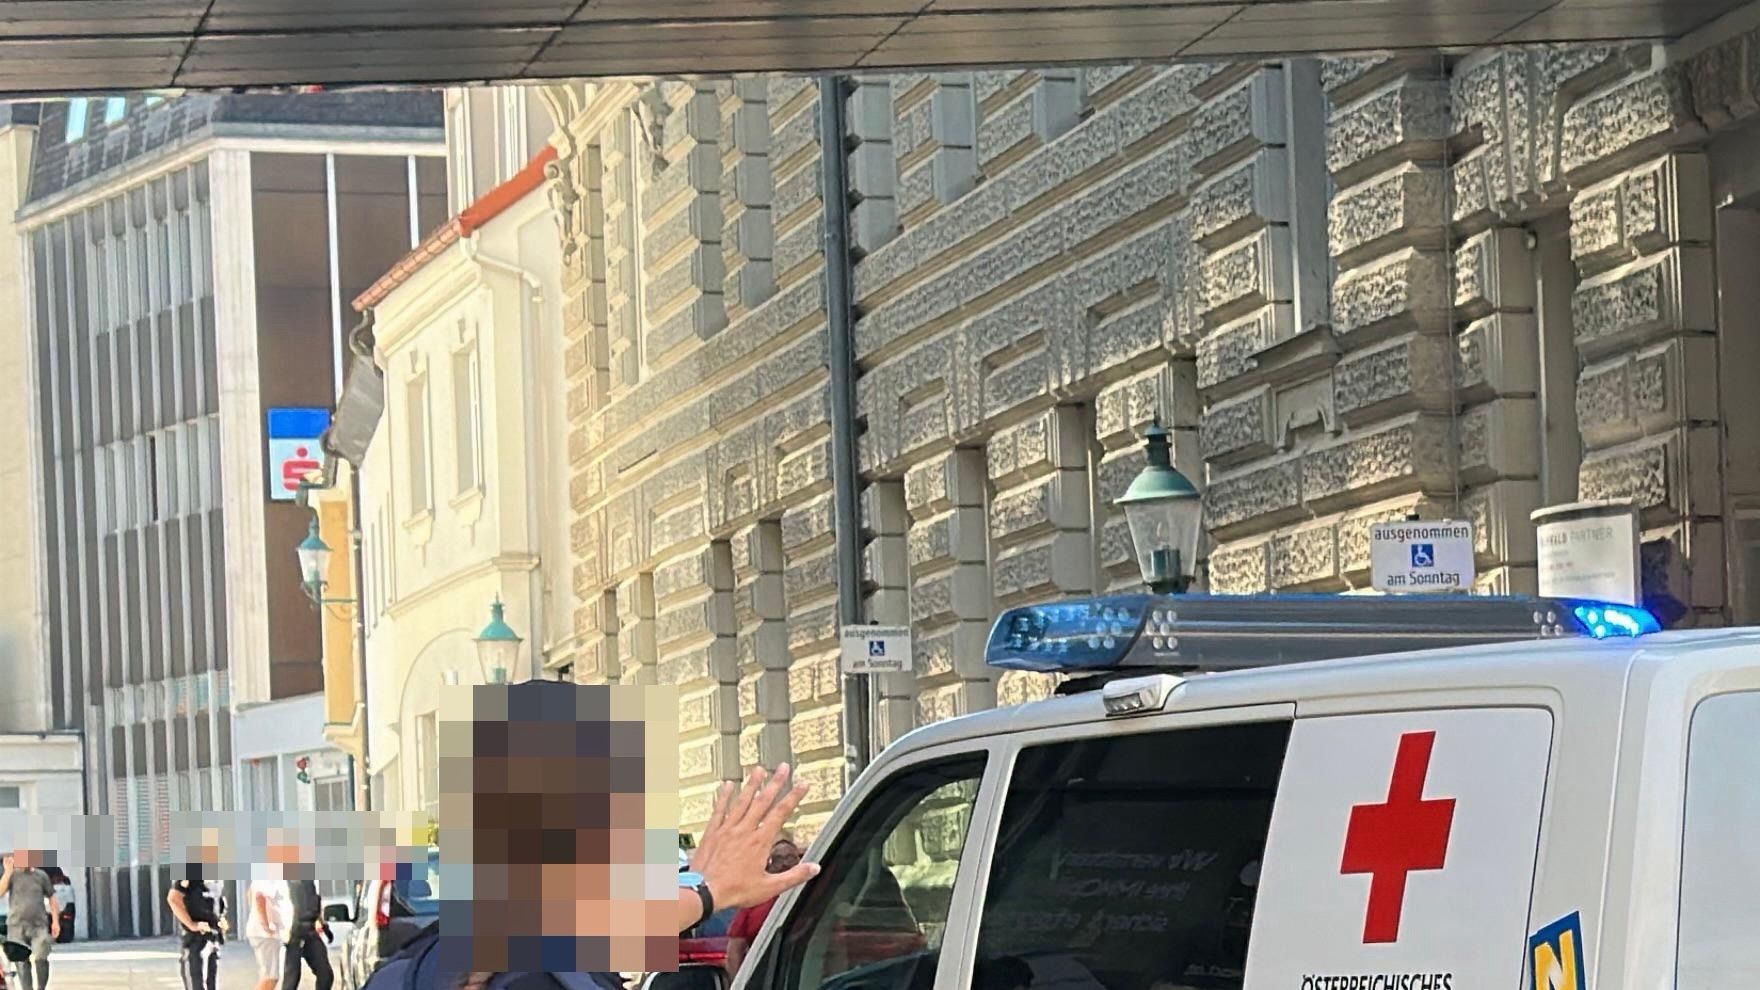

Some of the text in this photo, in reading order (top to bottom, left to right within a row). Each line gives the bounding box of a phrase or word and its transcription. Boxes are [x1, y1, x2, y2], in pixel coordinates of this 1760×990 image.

[1375, 526, 1469, 542] ausgenommen
[1387, 571, 1460, 586] am Sonntag
